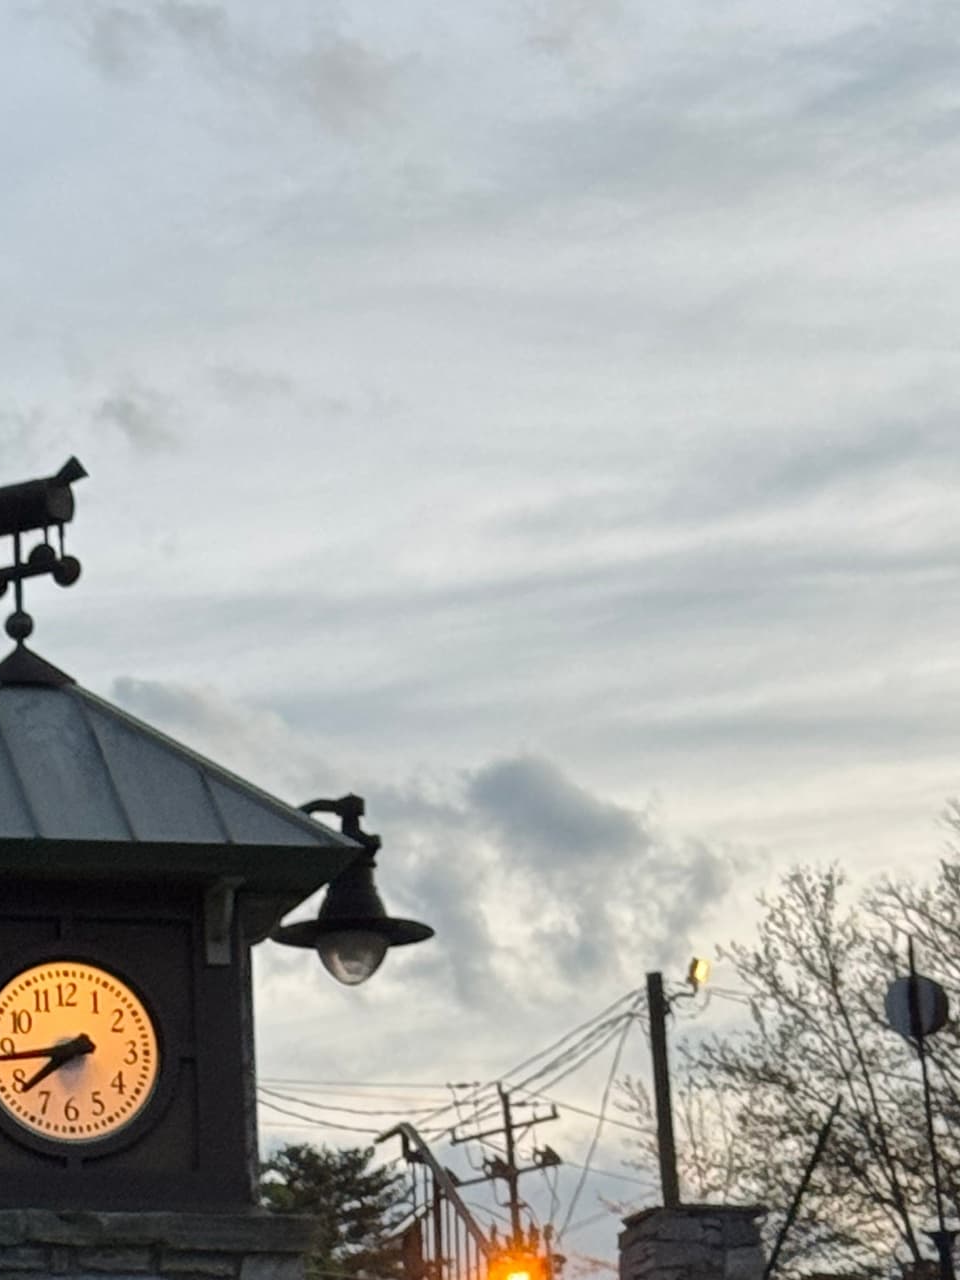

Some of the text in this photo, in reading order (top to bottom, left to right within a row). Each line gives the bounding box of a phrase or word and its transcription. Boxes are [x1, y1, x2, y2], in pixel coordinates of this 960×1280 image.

[34, 989, 50, 1012] 11
[57, 983, 77, 1006] 12
[91, 990, 99, 1014] 1
[11, 1010, 32, 1034] 10
[111, 1009, 124, 1033] 2
[0, 1038, 15, 1056] 9
[124, 1041, 138, 1064] 3
[12, 1069, 26, 1094] 8
[111, 1071, 126, 1095] 4
[39, 1091, 51, 1115] 7
[64, 1097, 79, 1121] 6
[92, 1091, 105, 1116] 5
